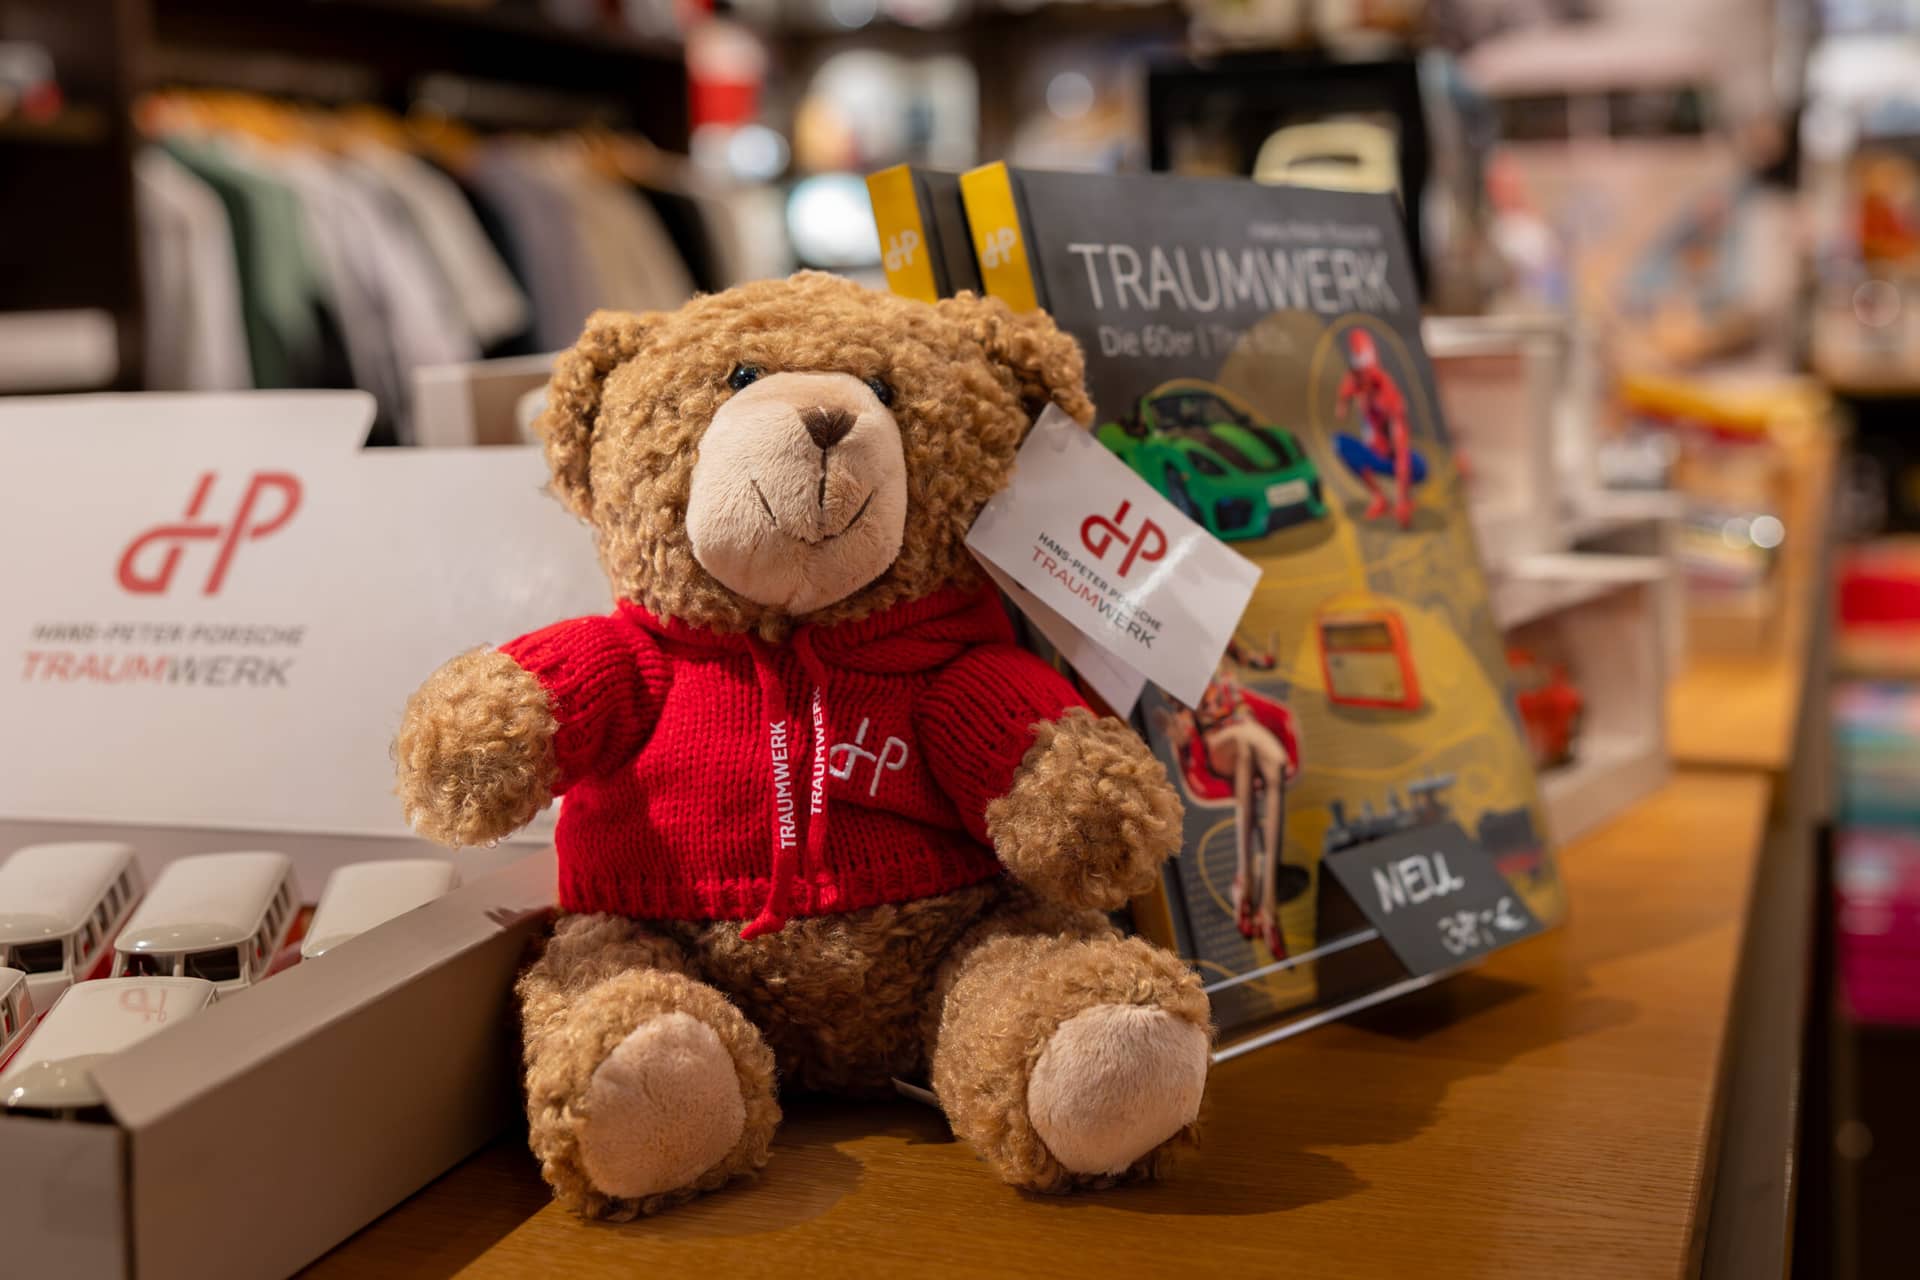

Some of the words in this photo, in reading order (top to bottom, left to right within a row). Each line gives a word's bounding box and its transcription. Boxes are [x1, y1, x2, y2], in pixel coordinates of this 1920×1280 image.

[1067, 242, 1401, 314] TRAUMWERK
[1032, 544, 1157, 649] TRAUMWERK
[1038, 531, 1110, 592] HANS-PETER
[20, 651, 295, 688] TRAUMWERK
[770, 719, 797, 849] TRAUMWERK
